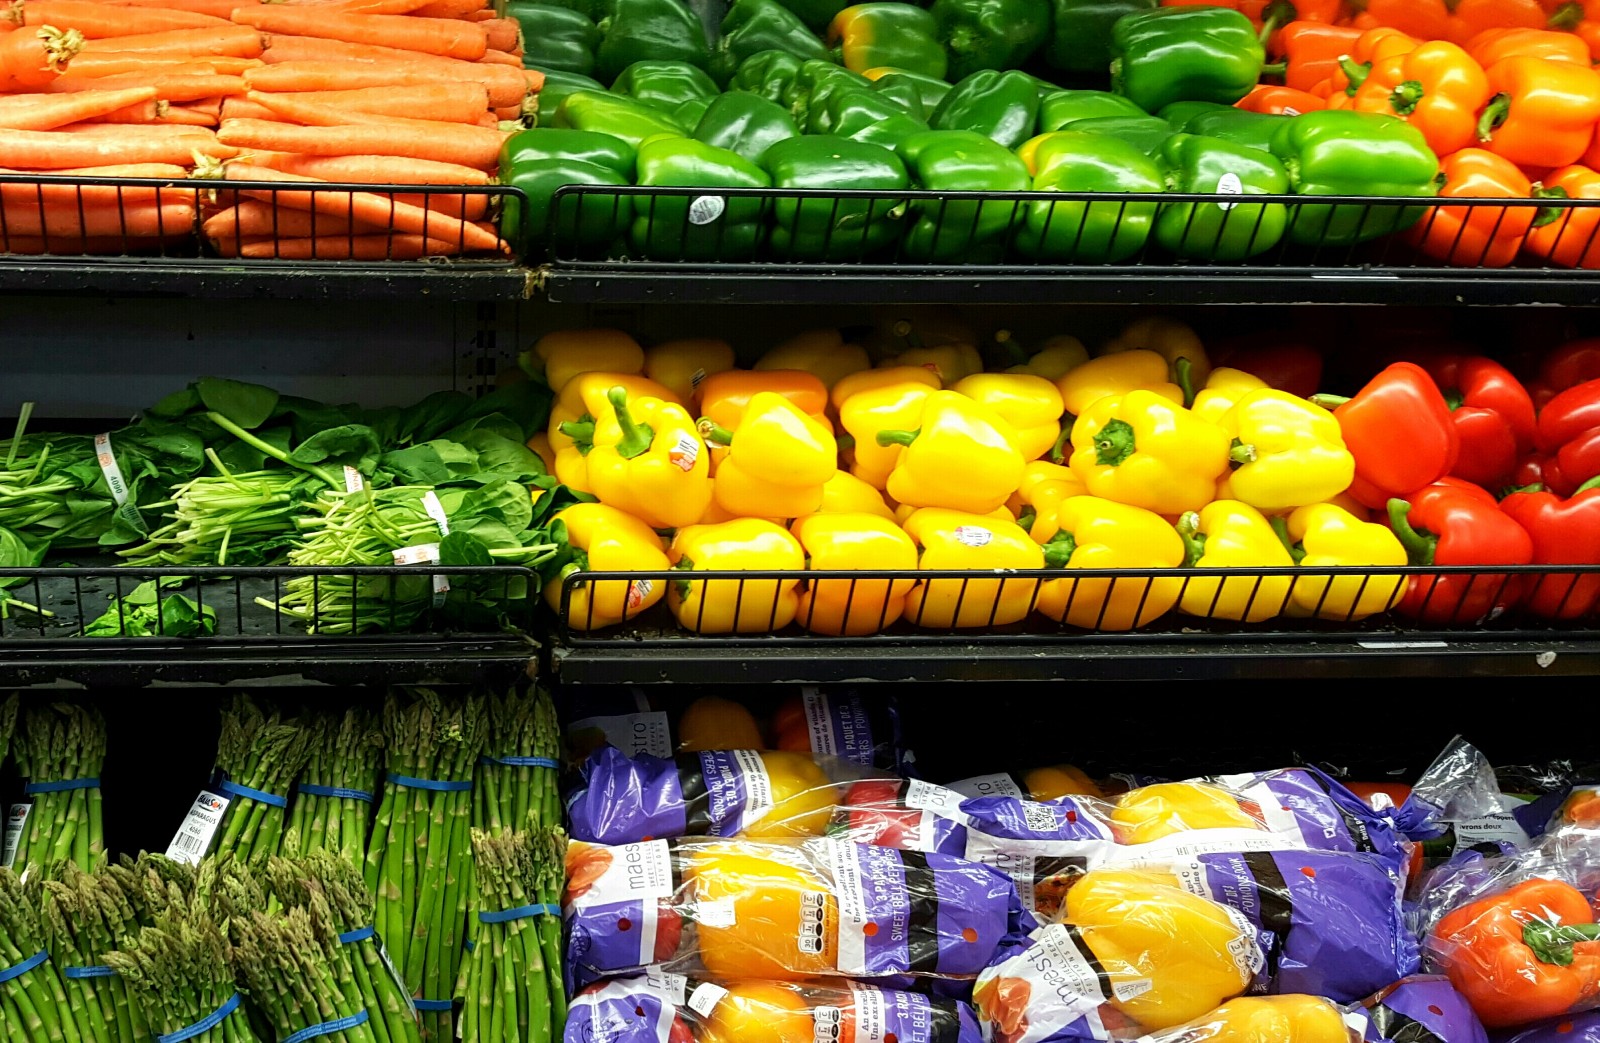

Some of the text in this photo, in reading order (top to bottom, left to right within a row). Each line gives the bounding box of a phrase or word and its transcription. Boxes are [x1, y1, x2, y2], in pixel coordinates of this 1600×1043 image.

[110, 476, 123, 494] 4090
[840, 711, 851, 719] DE
[841, 720, 856, 750] PAQUET
[710, 780, 726, 821] POIVRONS
[725, 790, 737, 801] DE
[190, 809, 217, 824] ASPARAGUS
[625, 844, 645, 890] maes
[1190, 862, 1199, 870] C
[883, 848, 904, 941] SWEET BELL PEPPERS
[804, 939, 811, 948] 30
[861, 1017, 869, 1032] An
[911, 1006, 925, 1028] BELL
[869, 1022, 879, 1041] Une
